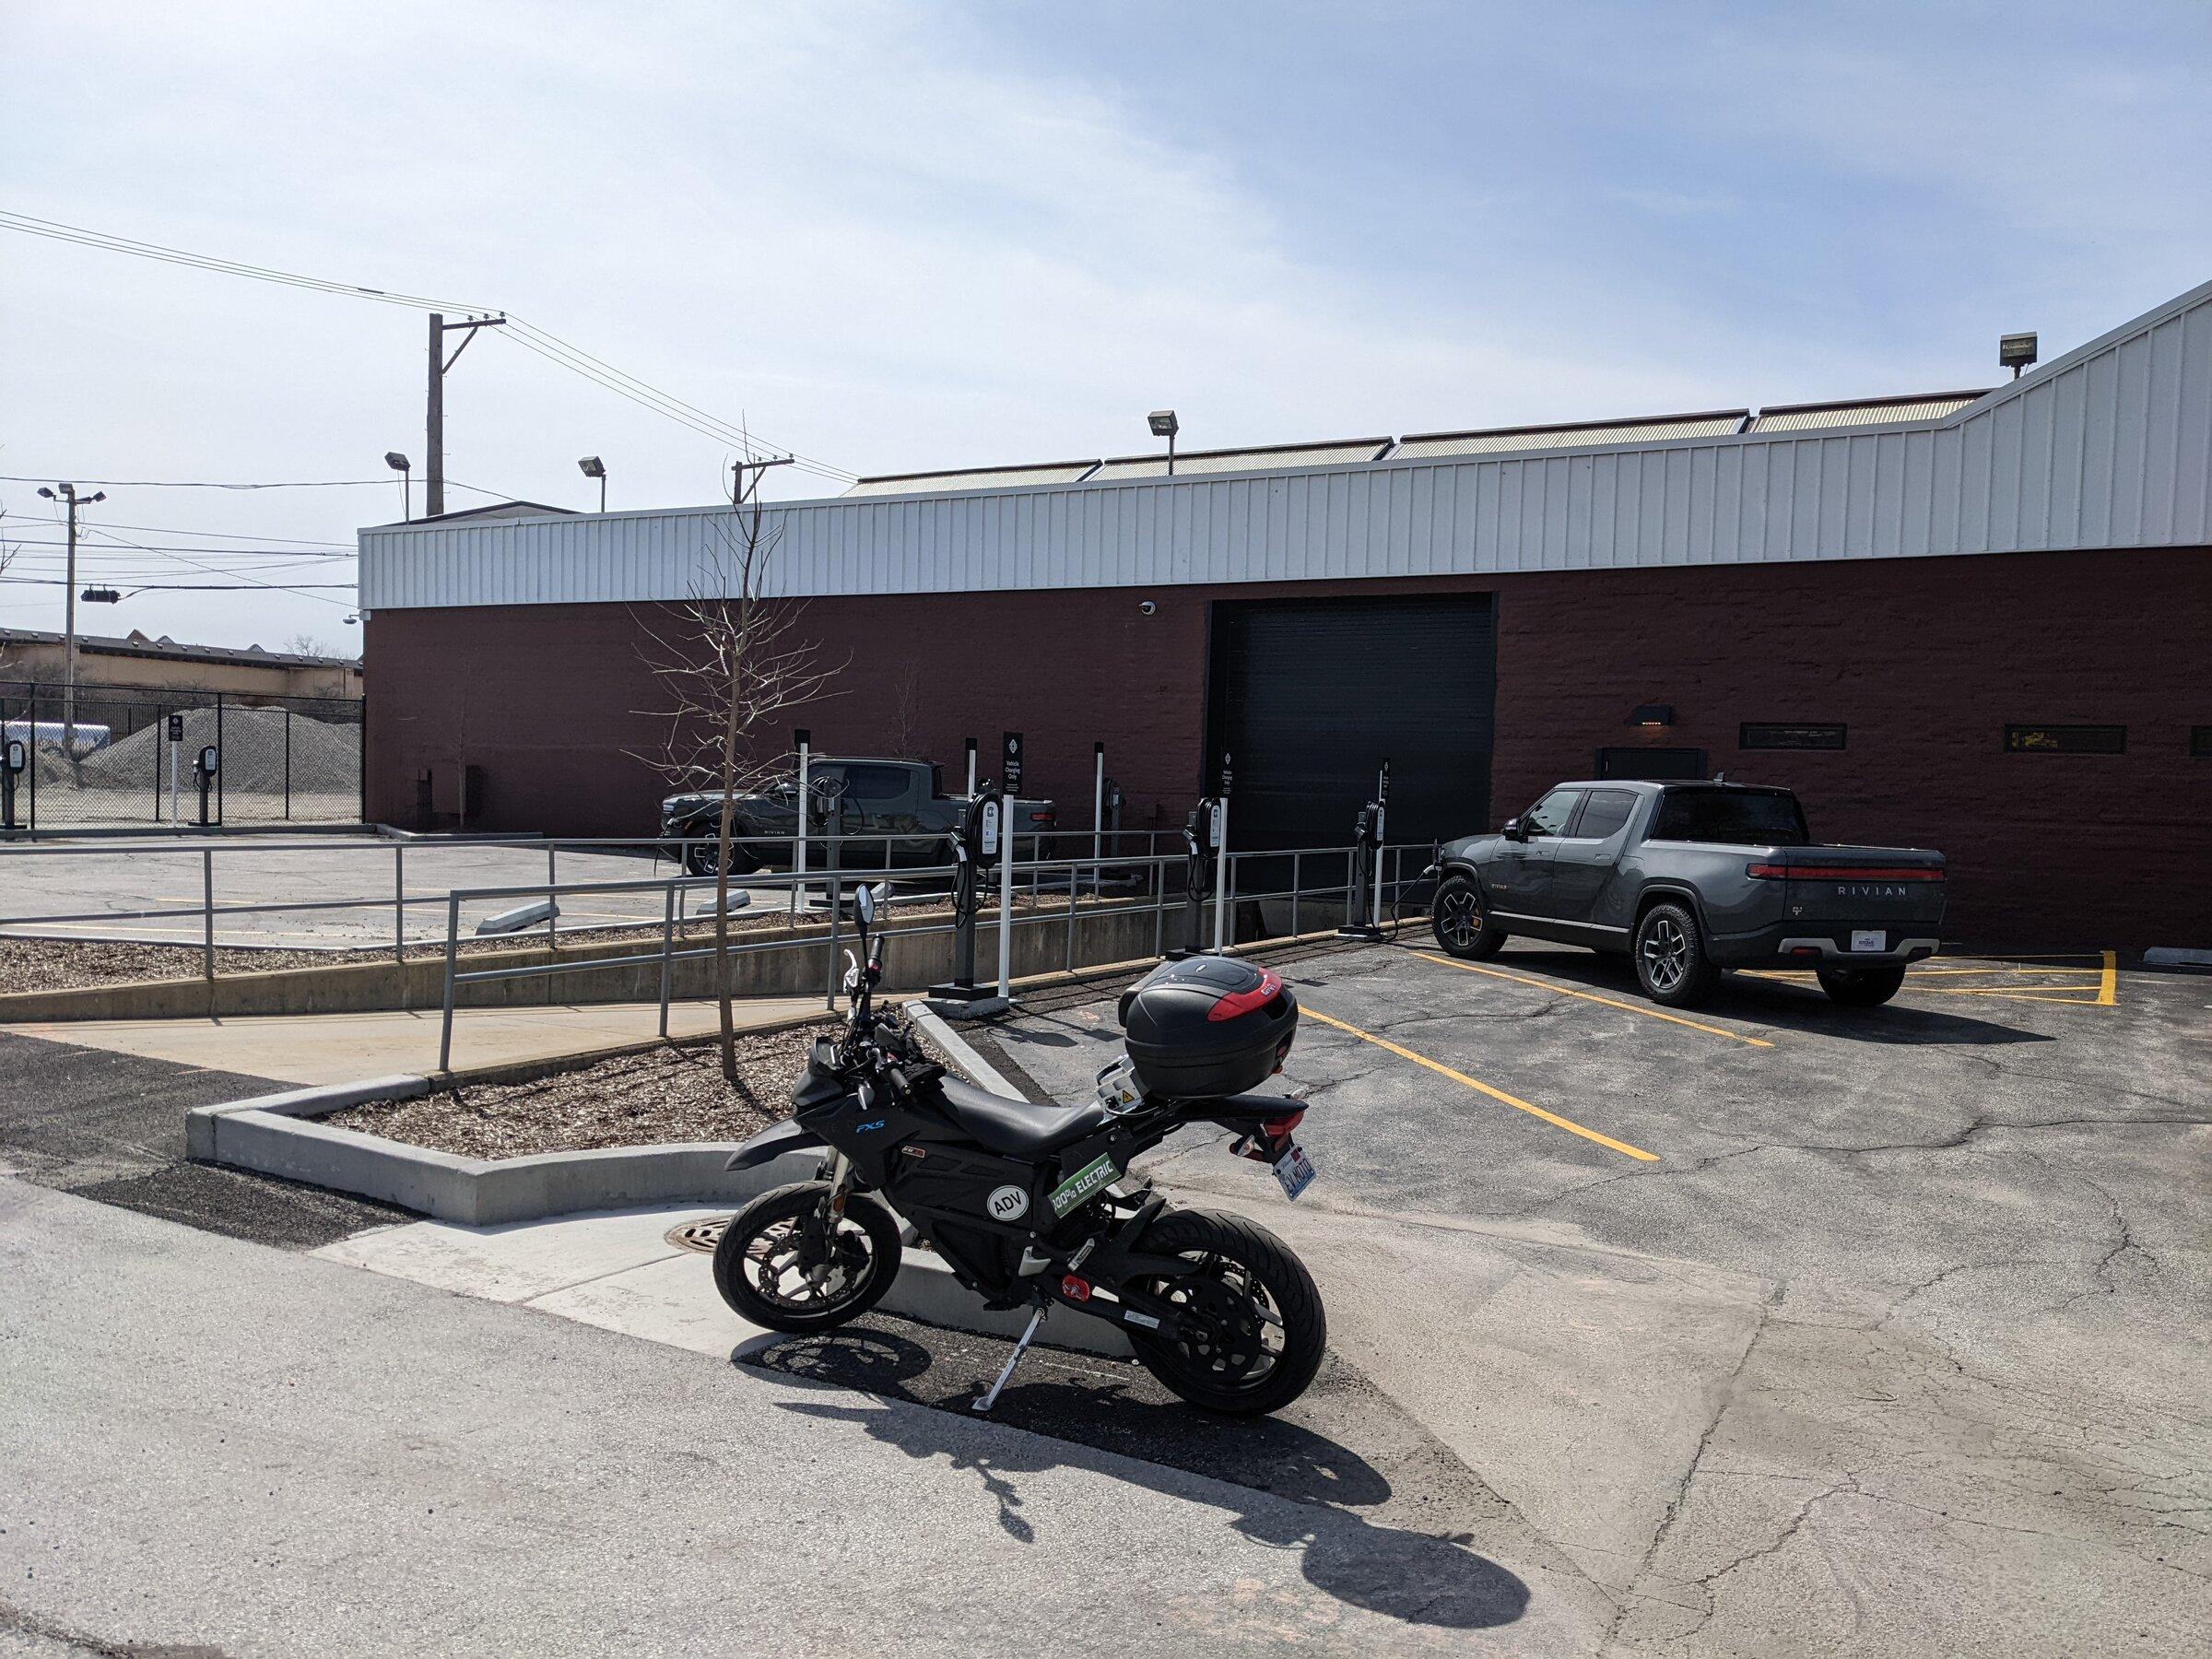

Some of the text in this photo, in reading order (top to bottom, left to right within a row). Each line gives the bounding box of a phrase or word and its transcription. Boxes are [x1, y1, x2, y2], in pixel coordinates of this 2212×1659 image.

[1838, 886, 1906, 896] RIVIAN
[856, 1120, 886, 1134] FXS
[1052, 1160, 1114, 1211] 100% ELECTRIC
[994, 1191, 1022, 1216] ADV
